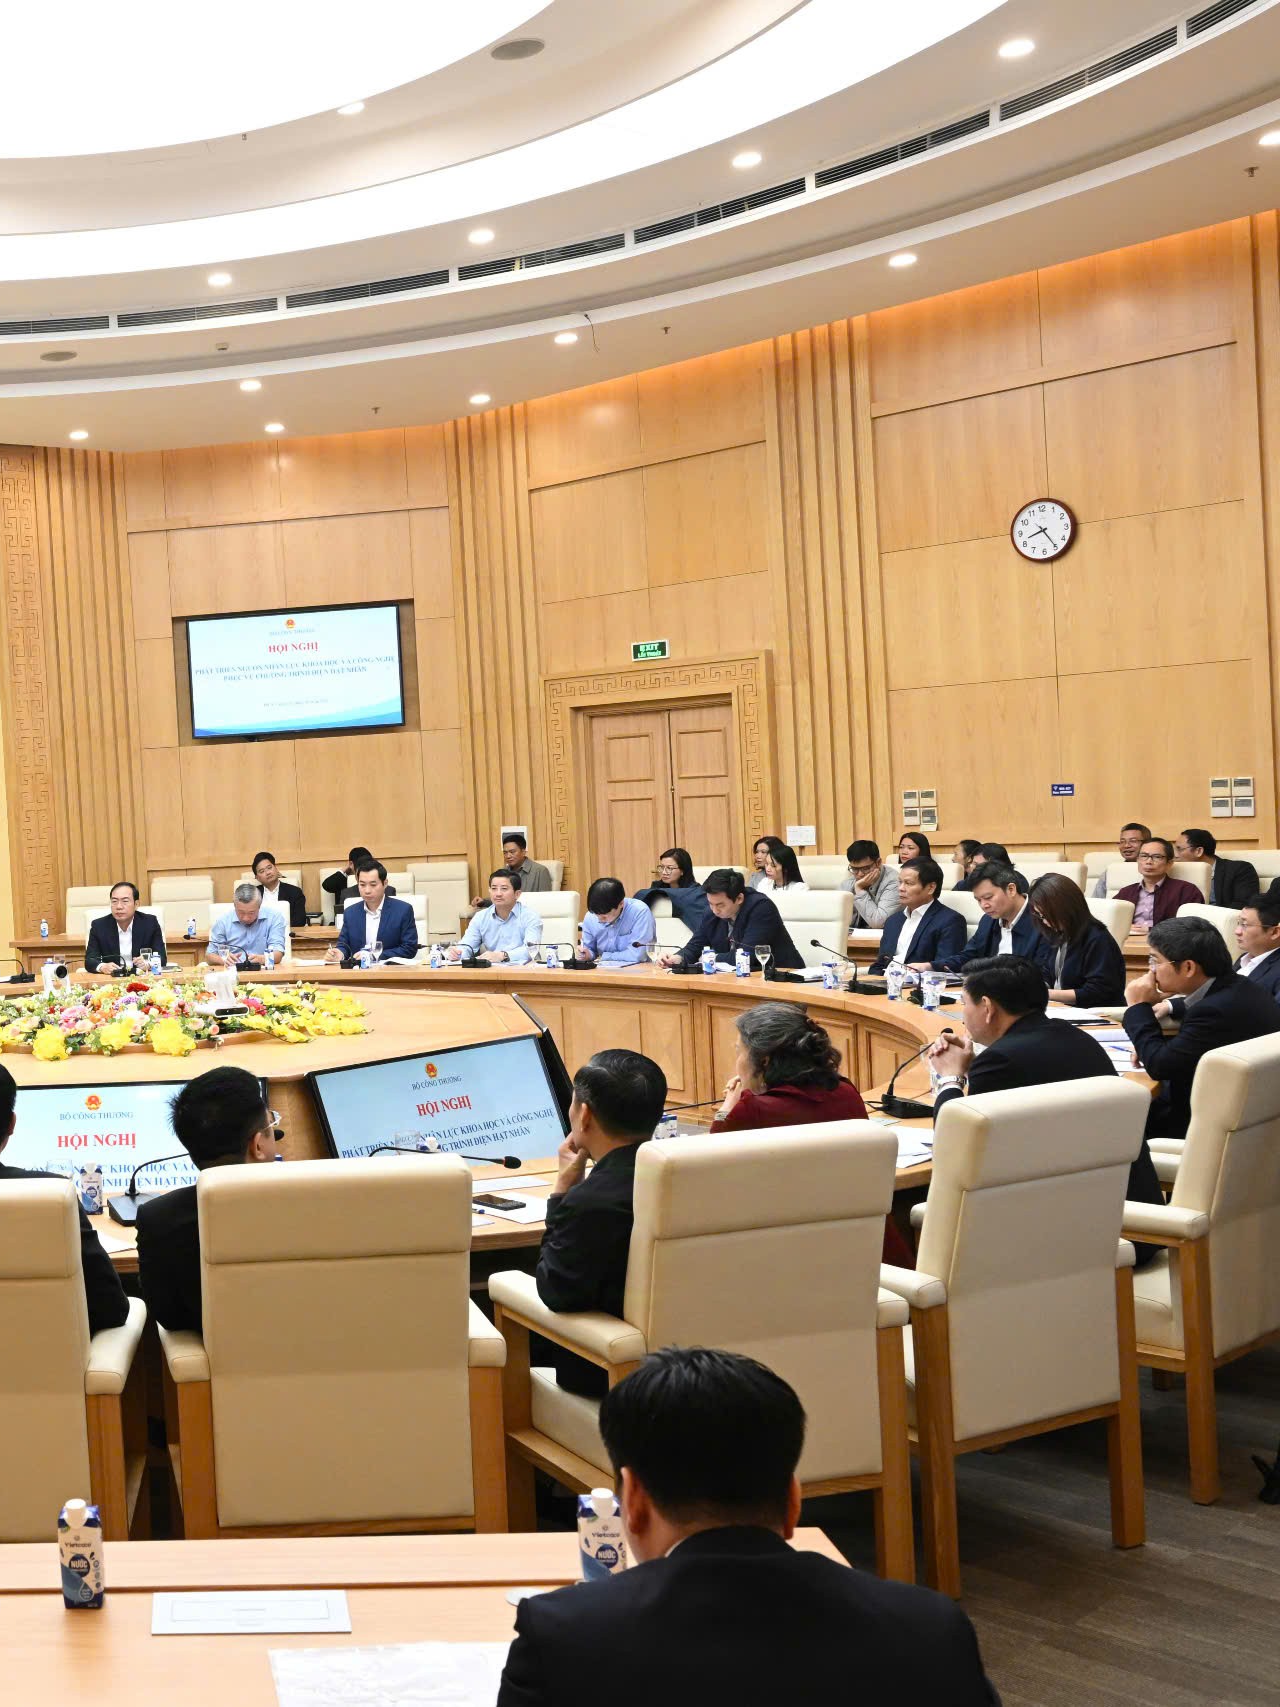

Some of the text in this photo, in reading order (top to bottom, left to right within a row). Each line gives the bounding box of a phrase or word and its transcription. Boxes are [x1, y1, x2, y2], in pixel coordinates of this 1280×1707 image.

[416, 1095, 472, 1117] HỘI NGHỊ
[73, 1111, 96, 1120] CÔNG
[97, 1111, 134, 1119] THƯƠNG
[443, 1127, 460, 1140] LỰC
[460, 1123, 483, 1134] KHOA
[483, 1120, 500, 1131] HỌC
[500, 1115, 512, 1126] VÀ
[512, 1112, 533, 1123] CÔNG
[534, 1107, 554, 1119] NGHỆ
[57, 1132, 136, 1150] HỘI NGHỊ
[449, 1138, 473, 1150] TRÌNH
[474, 1134, 493, 1146] ĐIỆN
[493, 1130, 509, 1143] HẠT
[509, 1126, 531, 1138] NHÂN
[341, 1146, 364, 1158] PHÁT
[110, 1164, 143, 1173] KHO
[145, 1162, 169, 1174] HỌC
